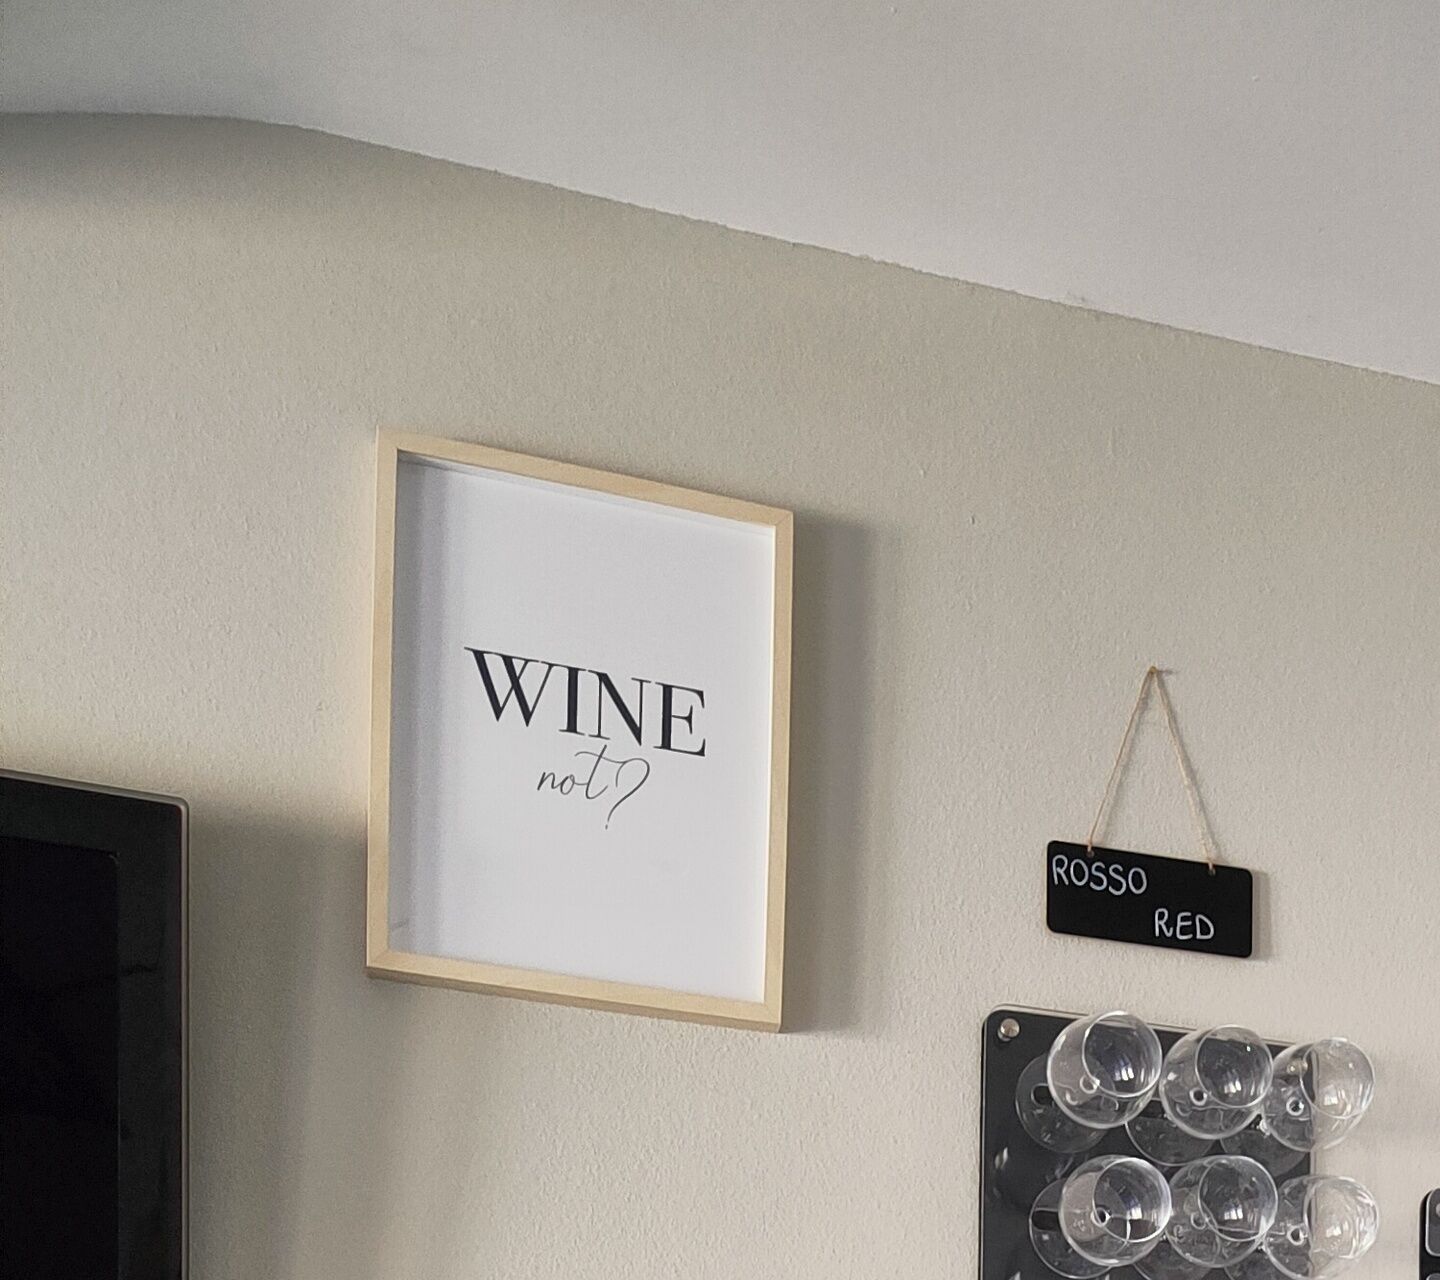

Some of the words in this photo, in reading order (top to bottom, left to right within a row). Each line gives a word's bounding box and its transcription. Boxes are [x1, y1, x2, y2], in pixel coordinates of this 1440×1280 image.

[464, 647, 706, 757] WINE
[537, 744, 651, 830] not?
[1051, 854, 1148, 896] ROSSO
[1153, 907, 1215, 940] RED
